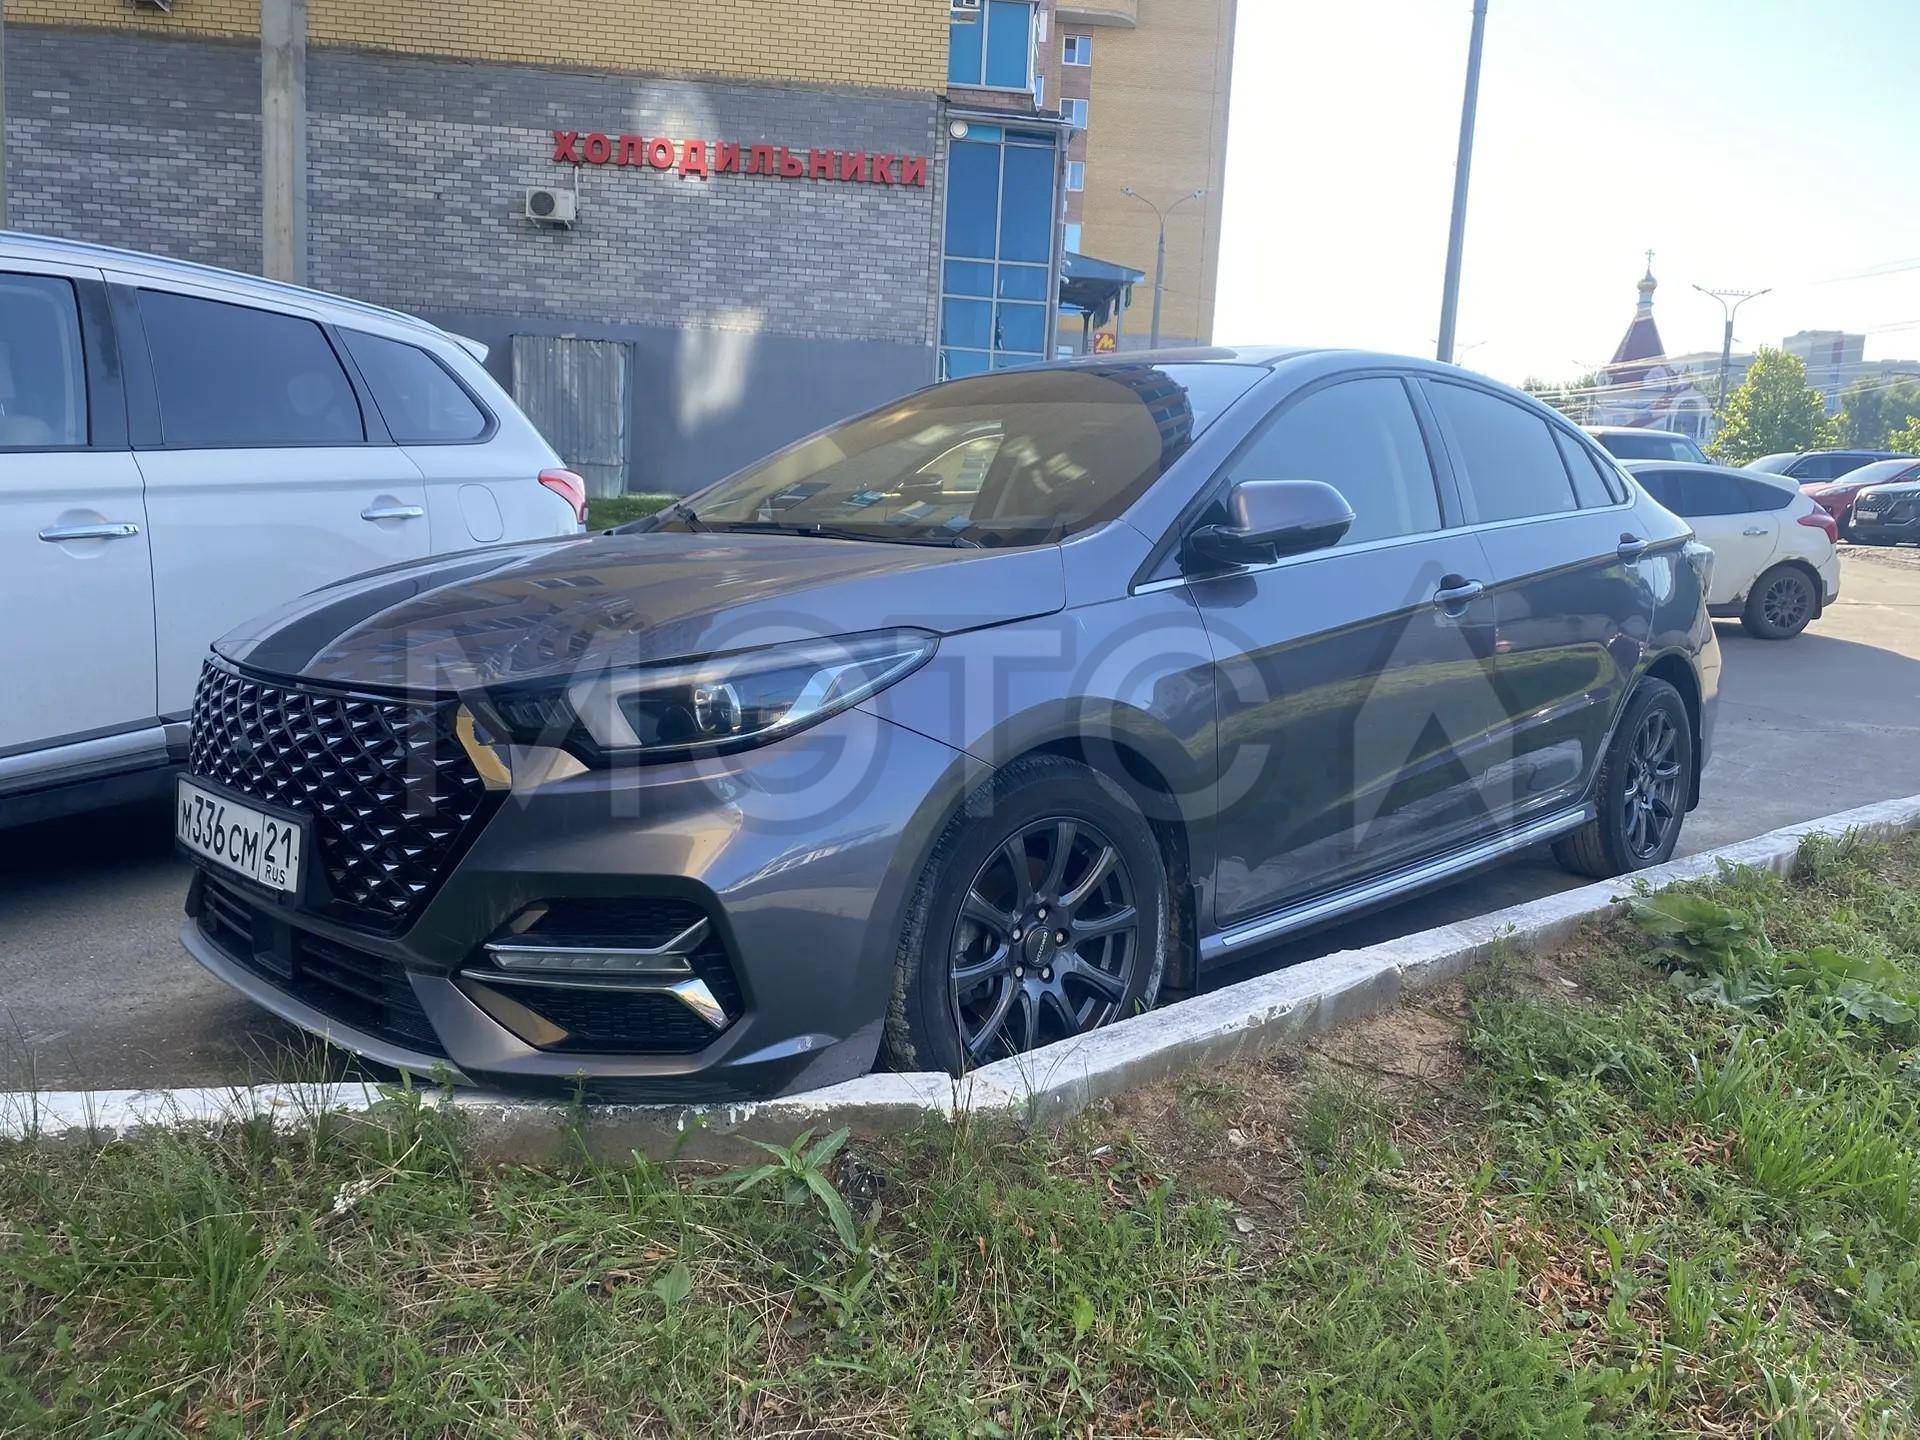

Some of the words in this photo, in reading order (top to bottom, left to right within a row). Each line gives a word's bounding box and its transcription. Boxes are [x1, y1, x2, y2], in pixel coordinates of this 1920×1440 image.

[552, 131, 927, 187] ХОЛОДИЛЬНИКИ
[264, 821, 293, 869] 21
[265, 864, 286, 885] RUS
